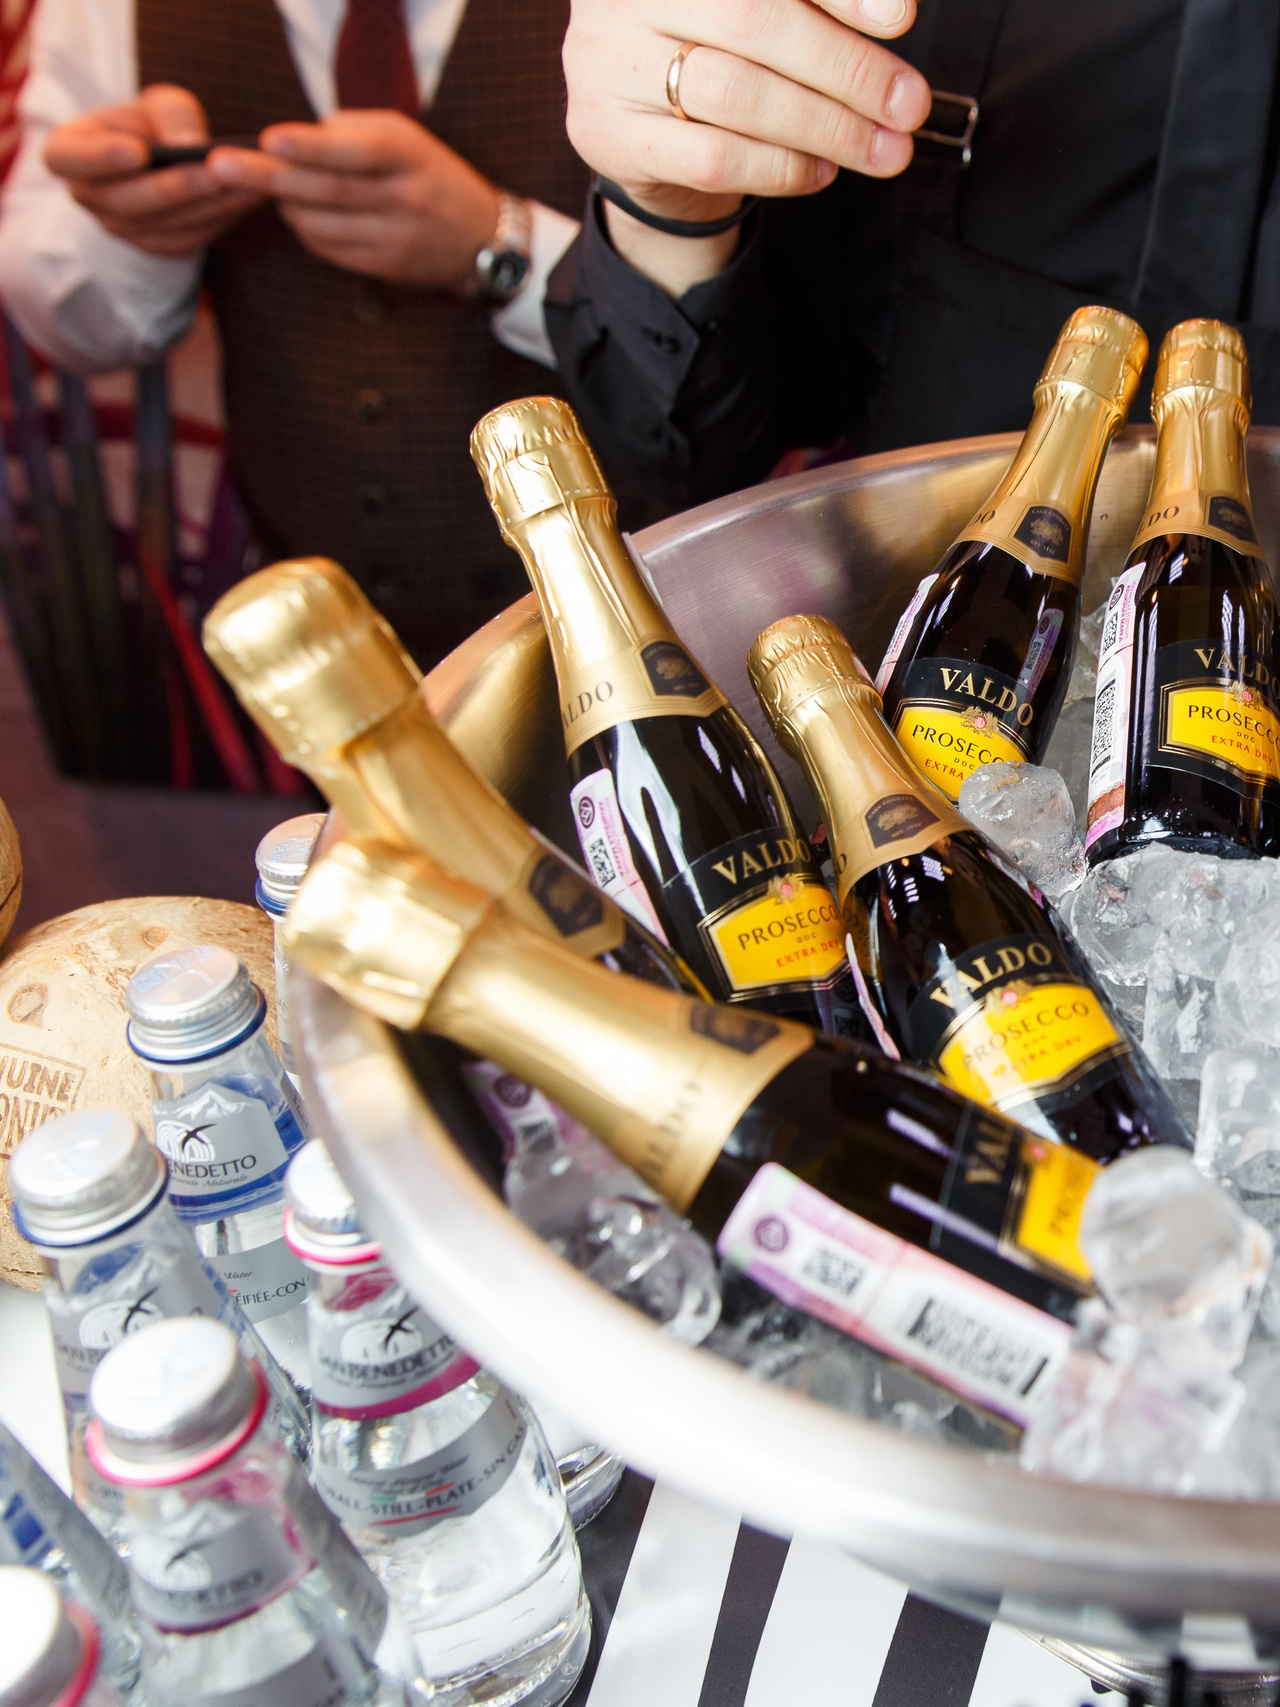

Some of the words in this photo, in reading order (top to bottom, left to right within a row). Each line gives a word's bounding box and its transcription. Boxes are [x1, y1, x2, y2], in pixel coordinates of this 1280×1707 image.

[939, 666, 1034, 727] VALDO
[911, 724, 1006, 766] PROSEC
[1211, 735, 1251, 756] EXTRA
[1254, 750, 1273, 767] DRY
[1236, 731, 1256, 743] DOC
[924, 758, 965, 781] EXTRA
[953, 756, 975, 771] DOC
[710, 838, 812, 885] VALDO
[737, 903, 840, 951] PROSECCO
[775, 946, 818, 969] EXTRA
[929, 942, 1053, 1010] VALDO
[963, 1000, 1091, 1073] PROSECCO
